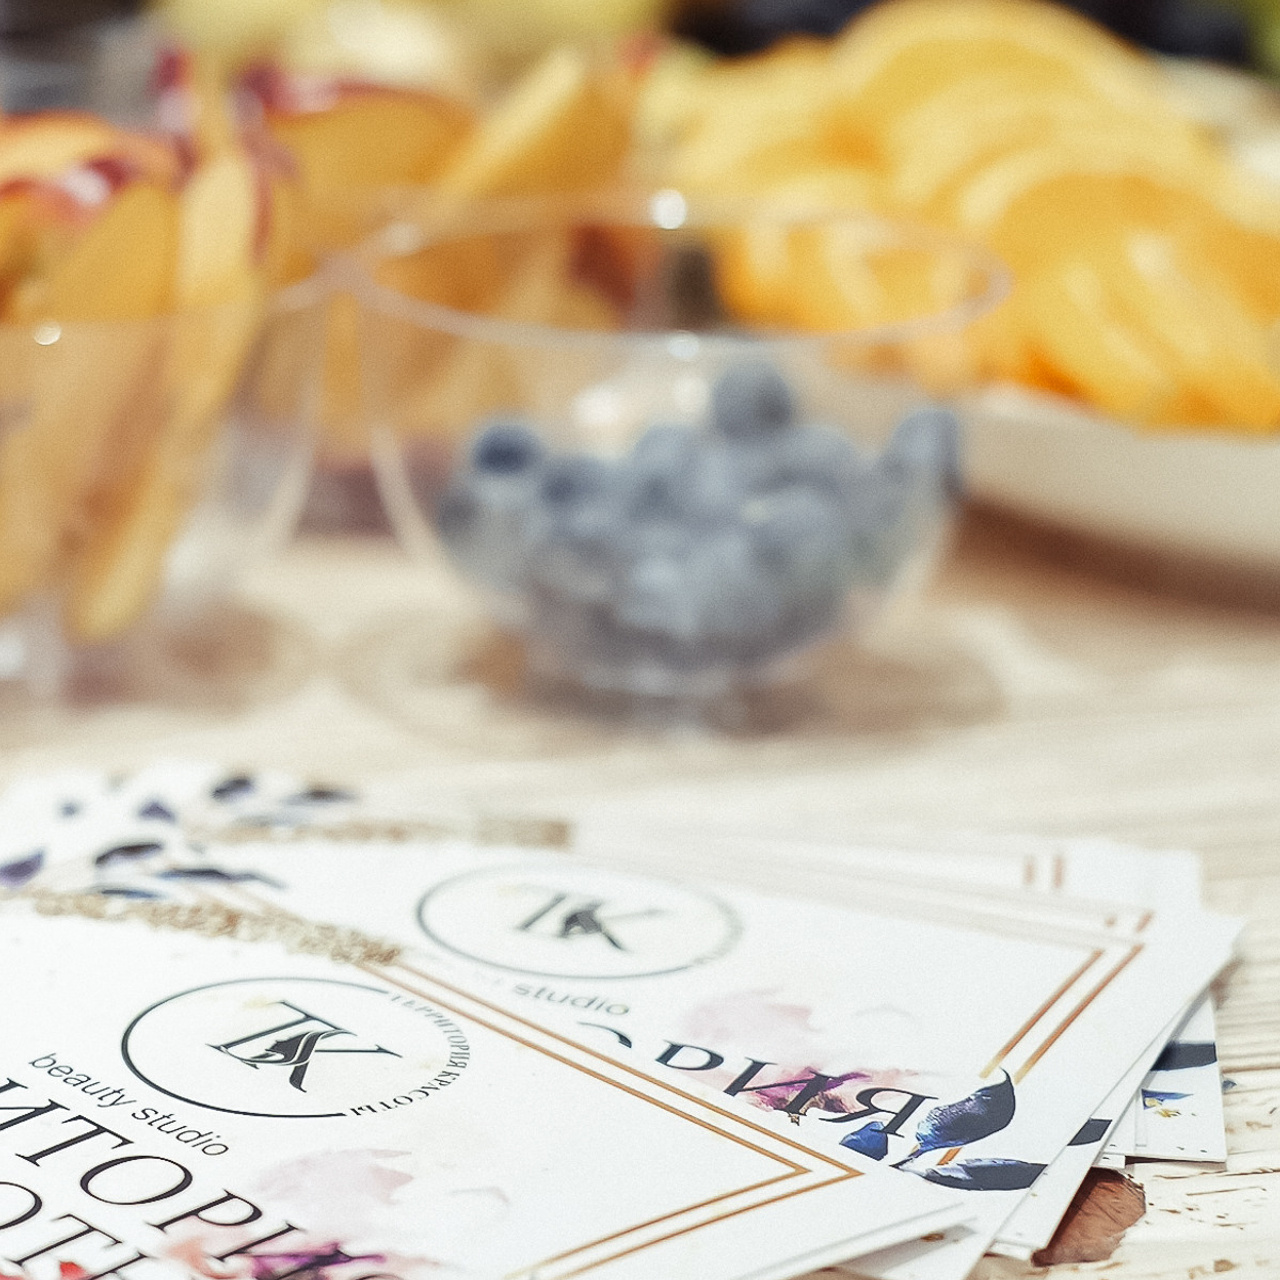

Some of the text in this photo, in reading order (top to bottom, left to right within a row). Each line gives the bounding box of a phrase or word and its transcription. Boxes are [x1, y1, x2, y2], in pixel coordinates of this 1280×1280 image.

[514, 982, 631, 1017] studio
[27, 1052, 230, 1156] beauty studio
